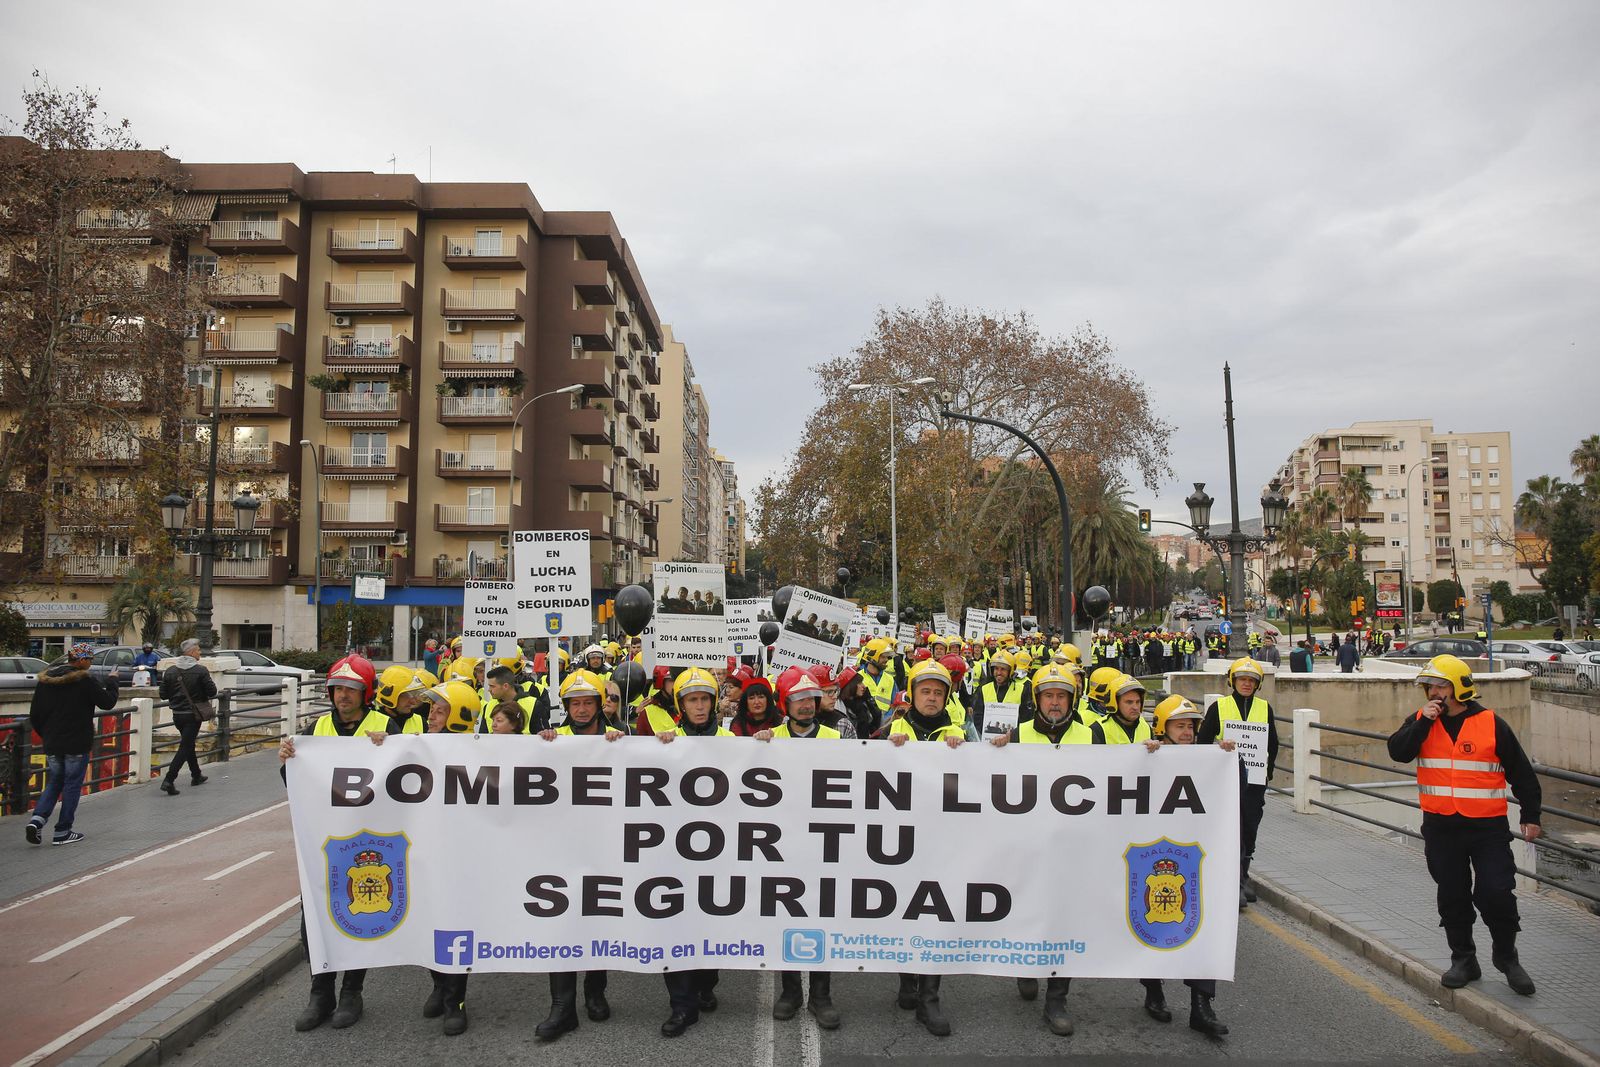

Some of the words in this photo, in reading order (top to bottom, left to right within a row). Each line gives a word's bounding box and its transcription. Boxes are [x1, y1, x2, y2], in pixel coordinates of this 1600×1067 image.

[515, 532, 589, 542] BOMBEROS
[546, 550, 560, 558] EN
[530, 566, 577, 577] LUCHA
[466, 581, 515, 590] BOMBERO
[534, 585, 556, 593] POR
[558, 584, 572, 592] TU
[517, 598, 590, 609] SEGURIDAD
[464, 630, 517, 638] SEGURIDAD
[681, 635, 706, 643] ANTES
[779, 648, 796, 658] 2014
[797, 654, 821, 665] ANTES
[1226, 723, 1267, 732] BOMBEROS
[1237, 742, 1258, 750] UCHA
[332, 764, 782, 807] BOMBEROS
[812, 770, 911, 810] EN
[943, 774, 1206, 815] LUCHA
[624, 821, 784, 862] POR
[809, 823, 914, 865] TU
[333, 901, 363, 935] CUERPO
[371, 925, 386, 935] DE
[391, 860, 404, 923] BOMBEROS
[524, 875, 1011, 922] SEGURIDAD
[1132, 909, 1158, 944] CUERPO
[1165, 936, 1181, 945] DE
[1184, 872, 1197, 935] BOMBEROS
[830, 933, 904, 946] Twitter:
[910, 935, 1086, 953] @encierrobombmlg
[477, 941, 584, 960] Bomberos
[590, 939, 665, 964] Málaga
[670, 944, 695, 959] en
[703, 939, 764, 957] Lucha
[830, 947, 913, 963] Hashtag:
[920, 949, 1065, 966] #encierroRCBM
